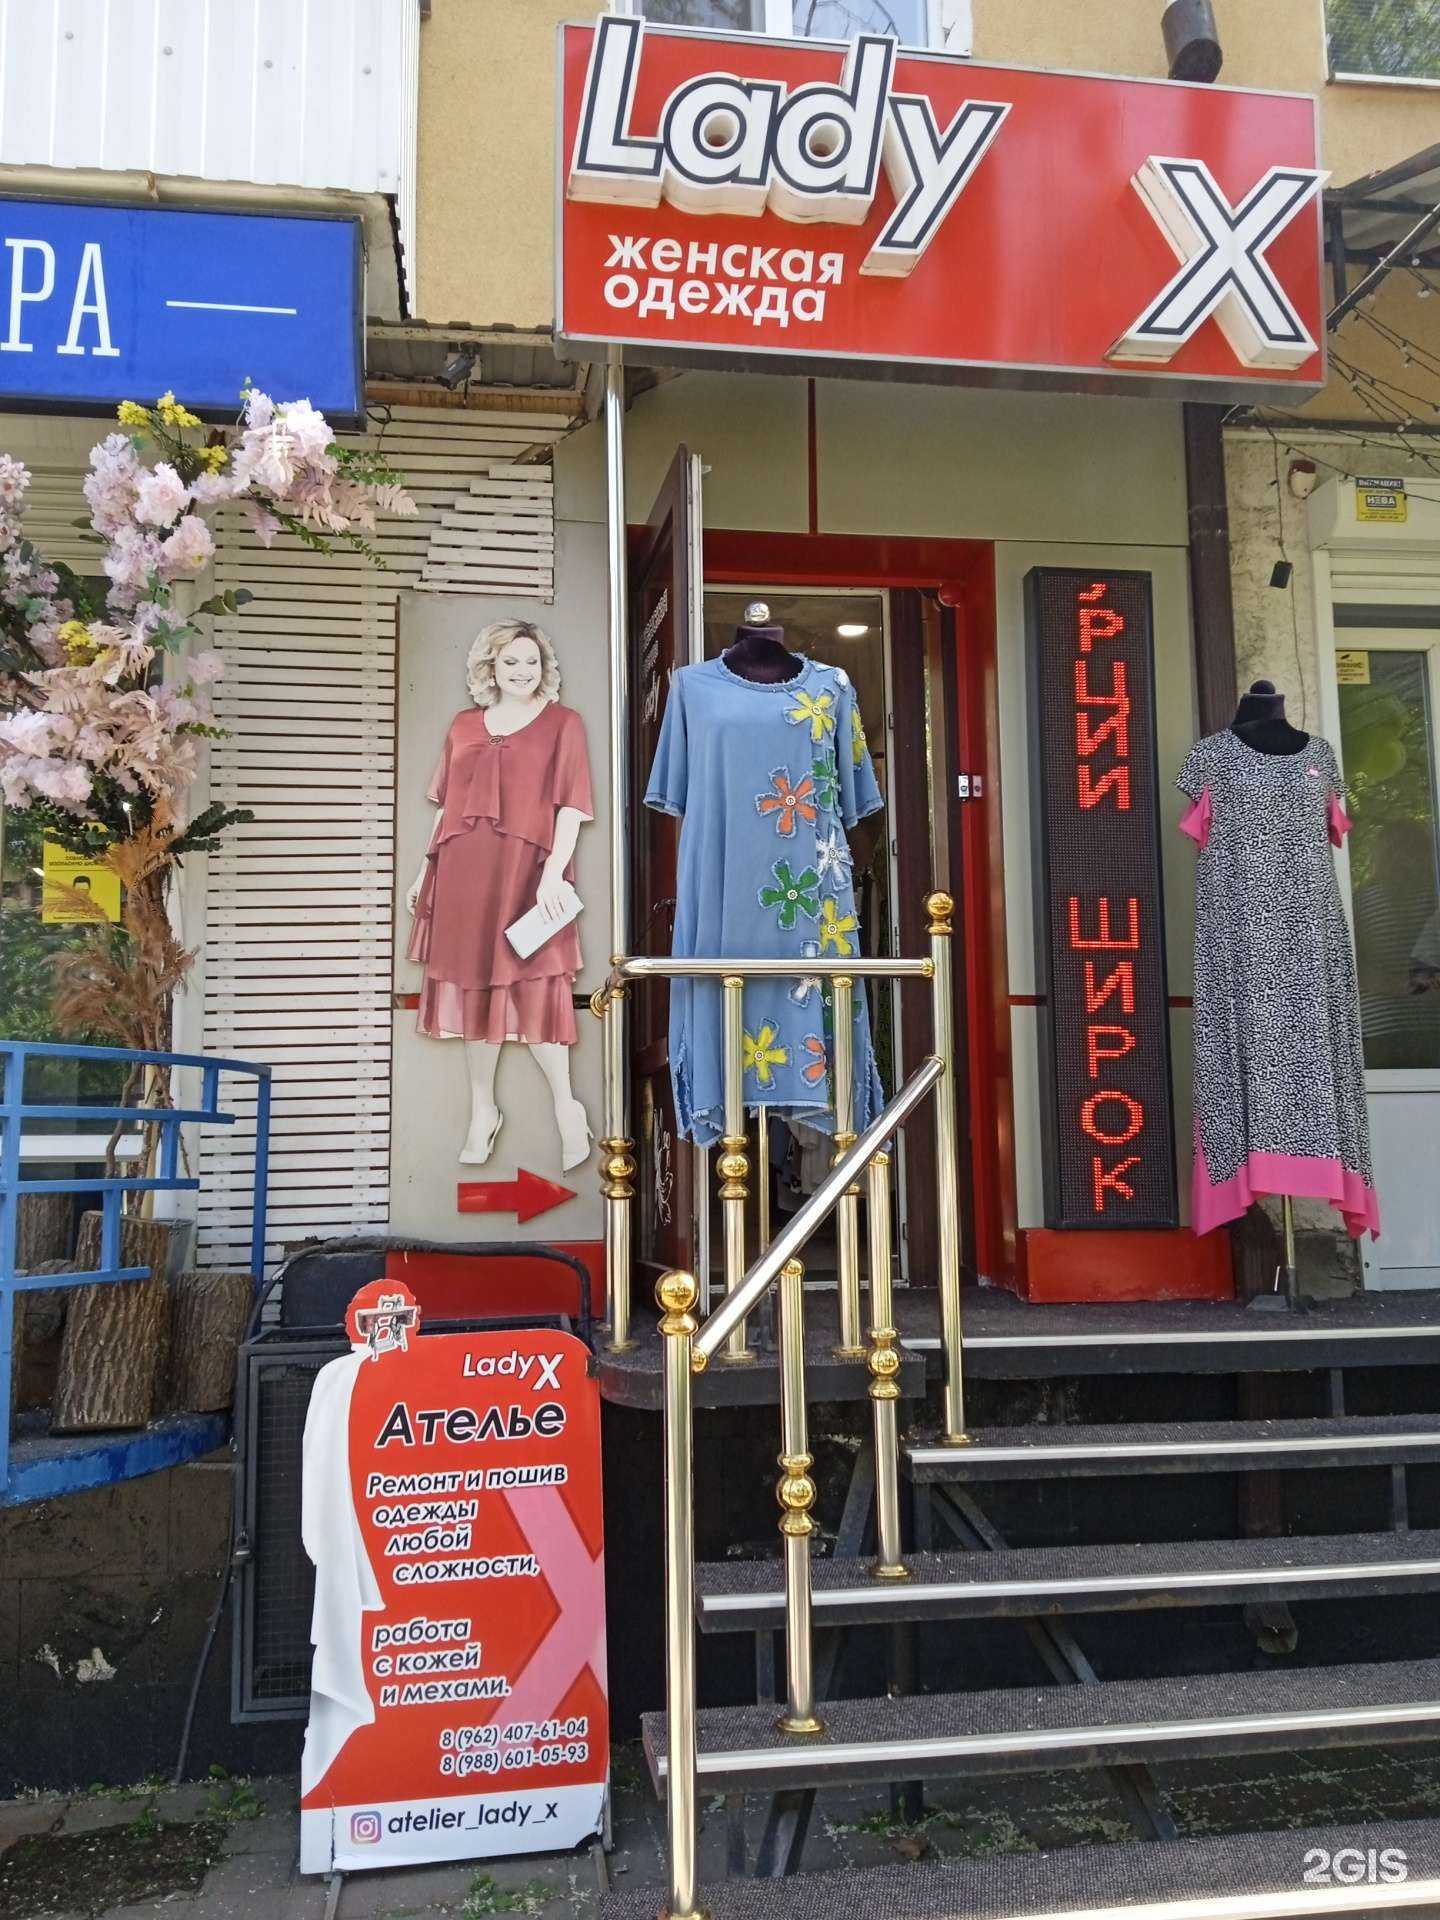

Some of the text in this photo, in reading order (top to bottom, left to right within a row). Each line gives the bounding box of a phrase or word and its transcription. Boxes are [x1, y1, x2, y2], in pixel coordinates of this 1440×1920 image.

[571, 15, 1332, 367] Lady X
[603, 234, 844, 285] женская
[603, 273, 826, 328] одежда
[375, 1402, 566, 1448] Ателье
[367, 1466, 567, 1495] Ремонт и пошив
[374, 1501, 477, 1526] одежды
[387, 1526, 470, 1553] любой
[395, 1556, 539, 1582] сложности,
[374, 1619, 470, 1649] работа
[374, 1644, 480, 1675] с кожей
[382, 1678, 511, 1704] и мехами.
[441, 1719, 586, 1749] 8 (962) 407-61-04
[441, 1744, 587, 1774] 8 (988) 601-05-93
[387, 1800, 559, 1834] atelier_lady_x
